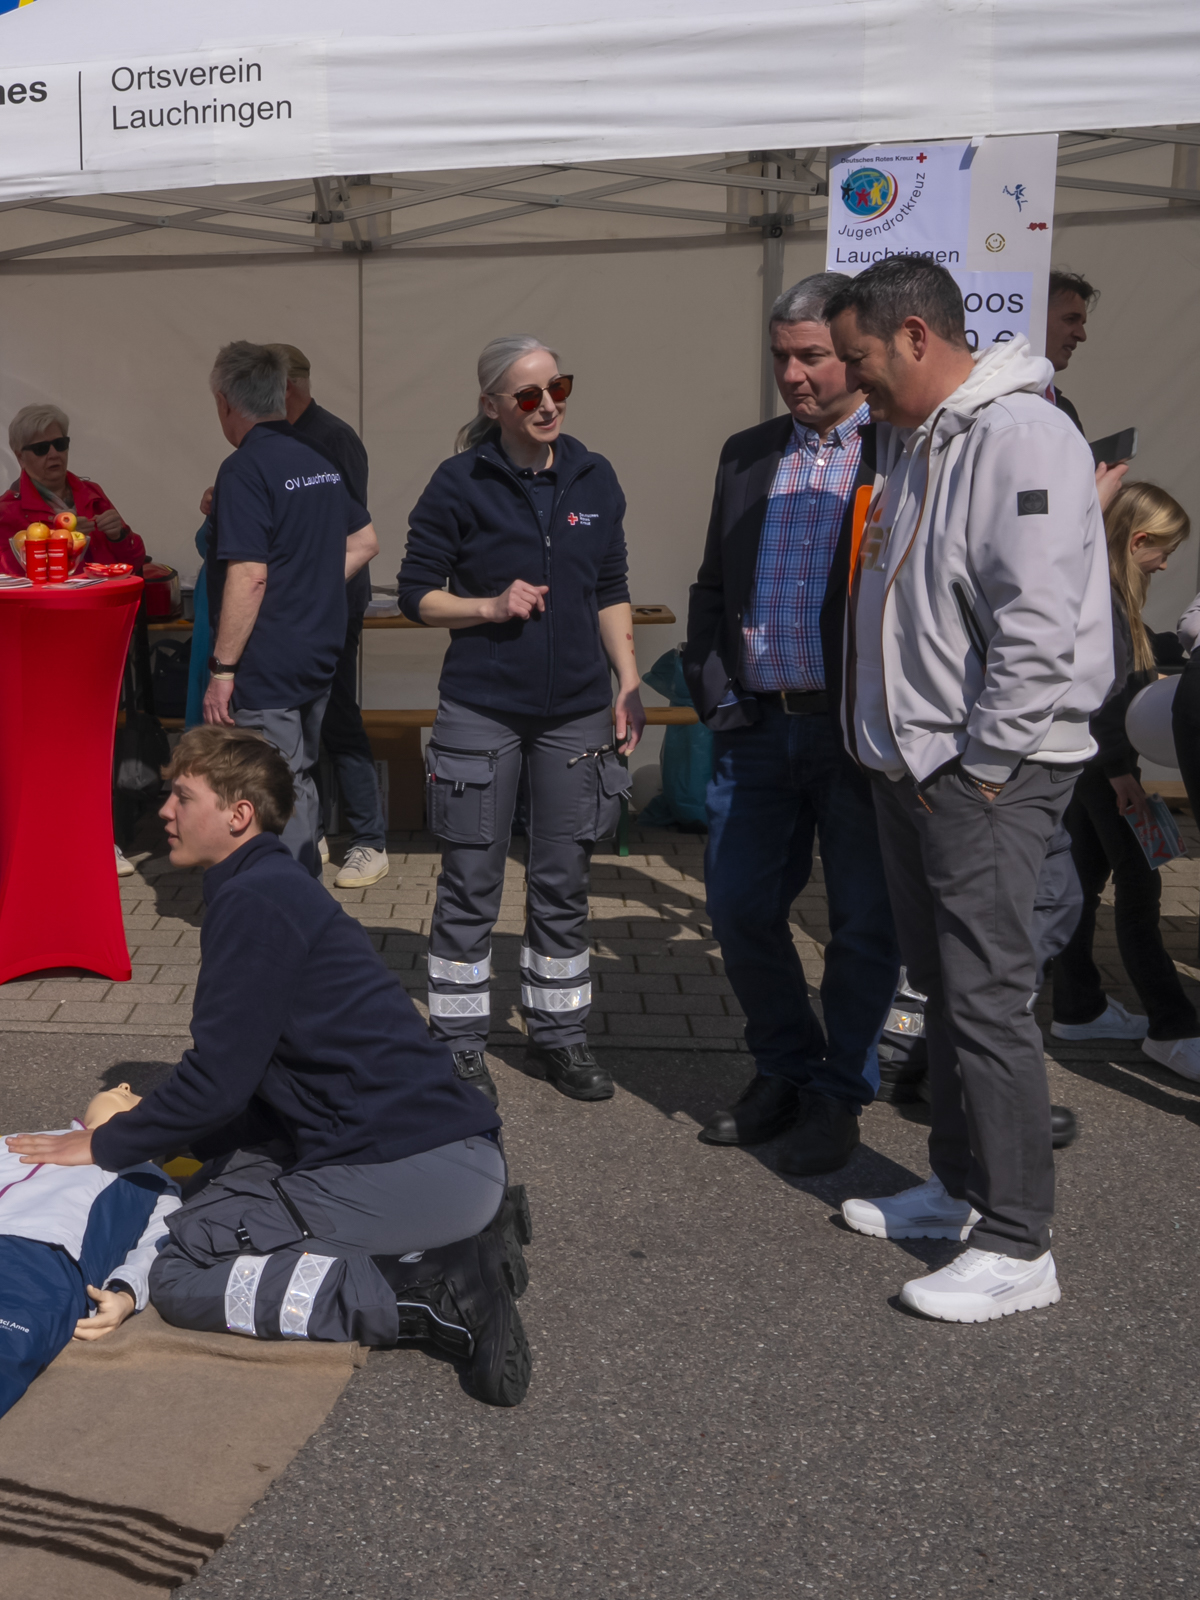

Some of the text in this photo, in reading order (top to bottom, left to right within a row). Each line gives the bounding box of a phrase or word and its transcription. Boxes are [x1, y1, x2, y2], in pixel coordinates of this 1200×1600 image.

[111, 58, 261, 92] Ortsverein
[112, 98, 292, 131] Lauchringen
[838, 172, 926, 241] Jugendrotkreuz
[284, 477, 301, 491] OV
[9, 1322, 30, 1334] Anne
